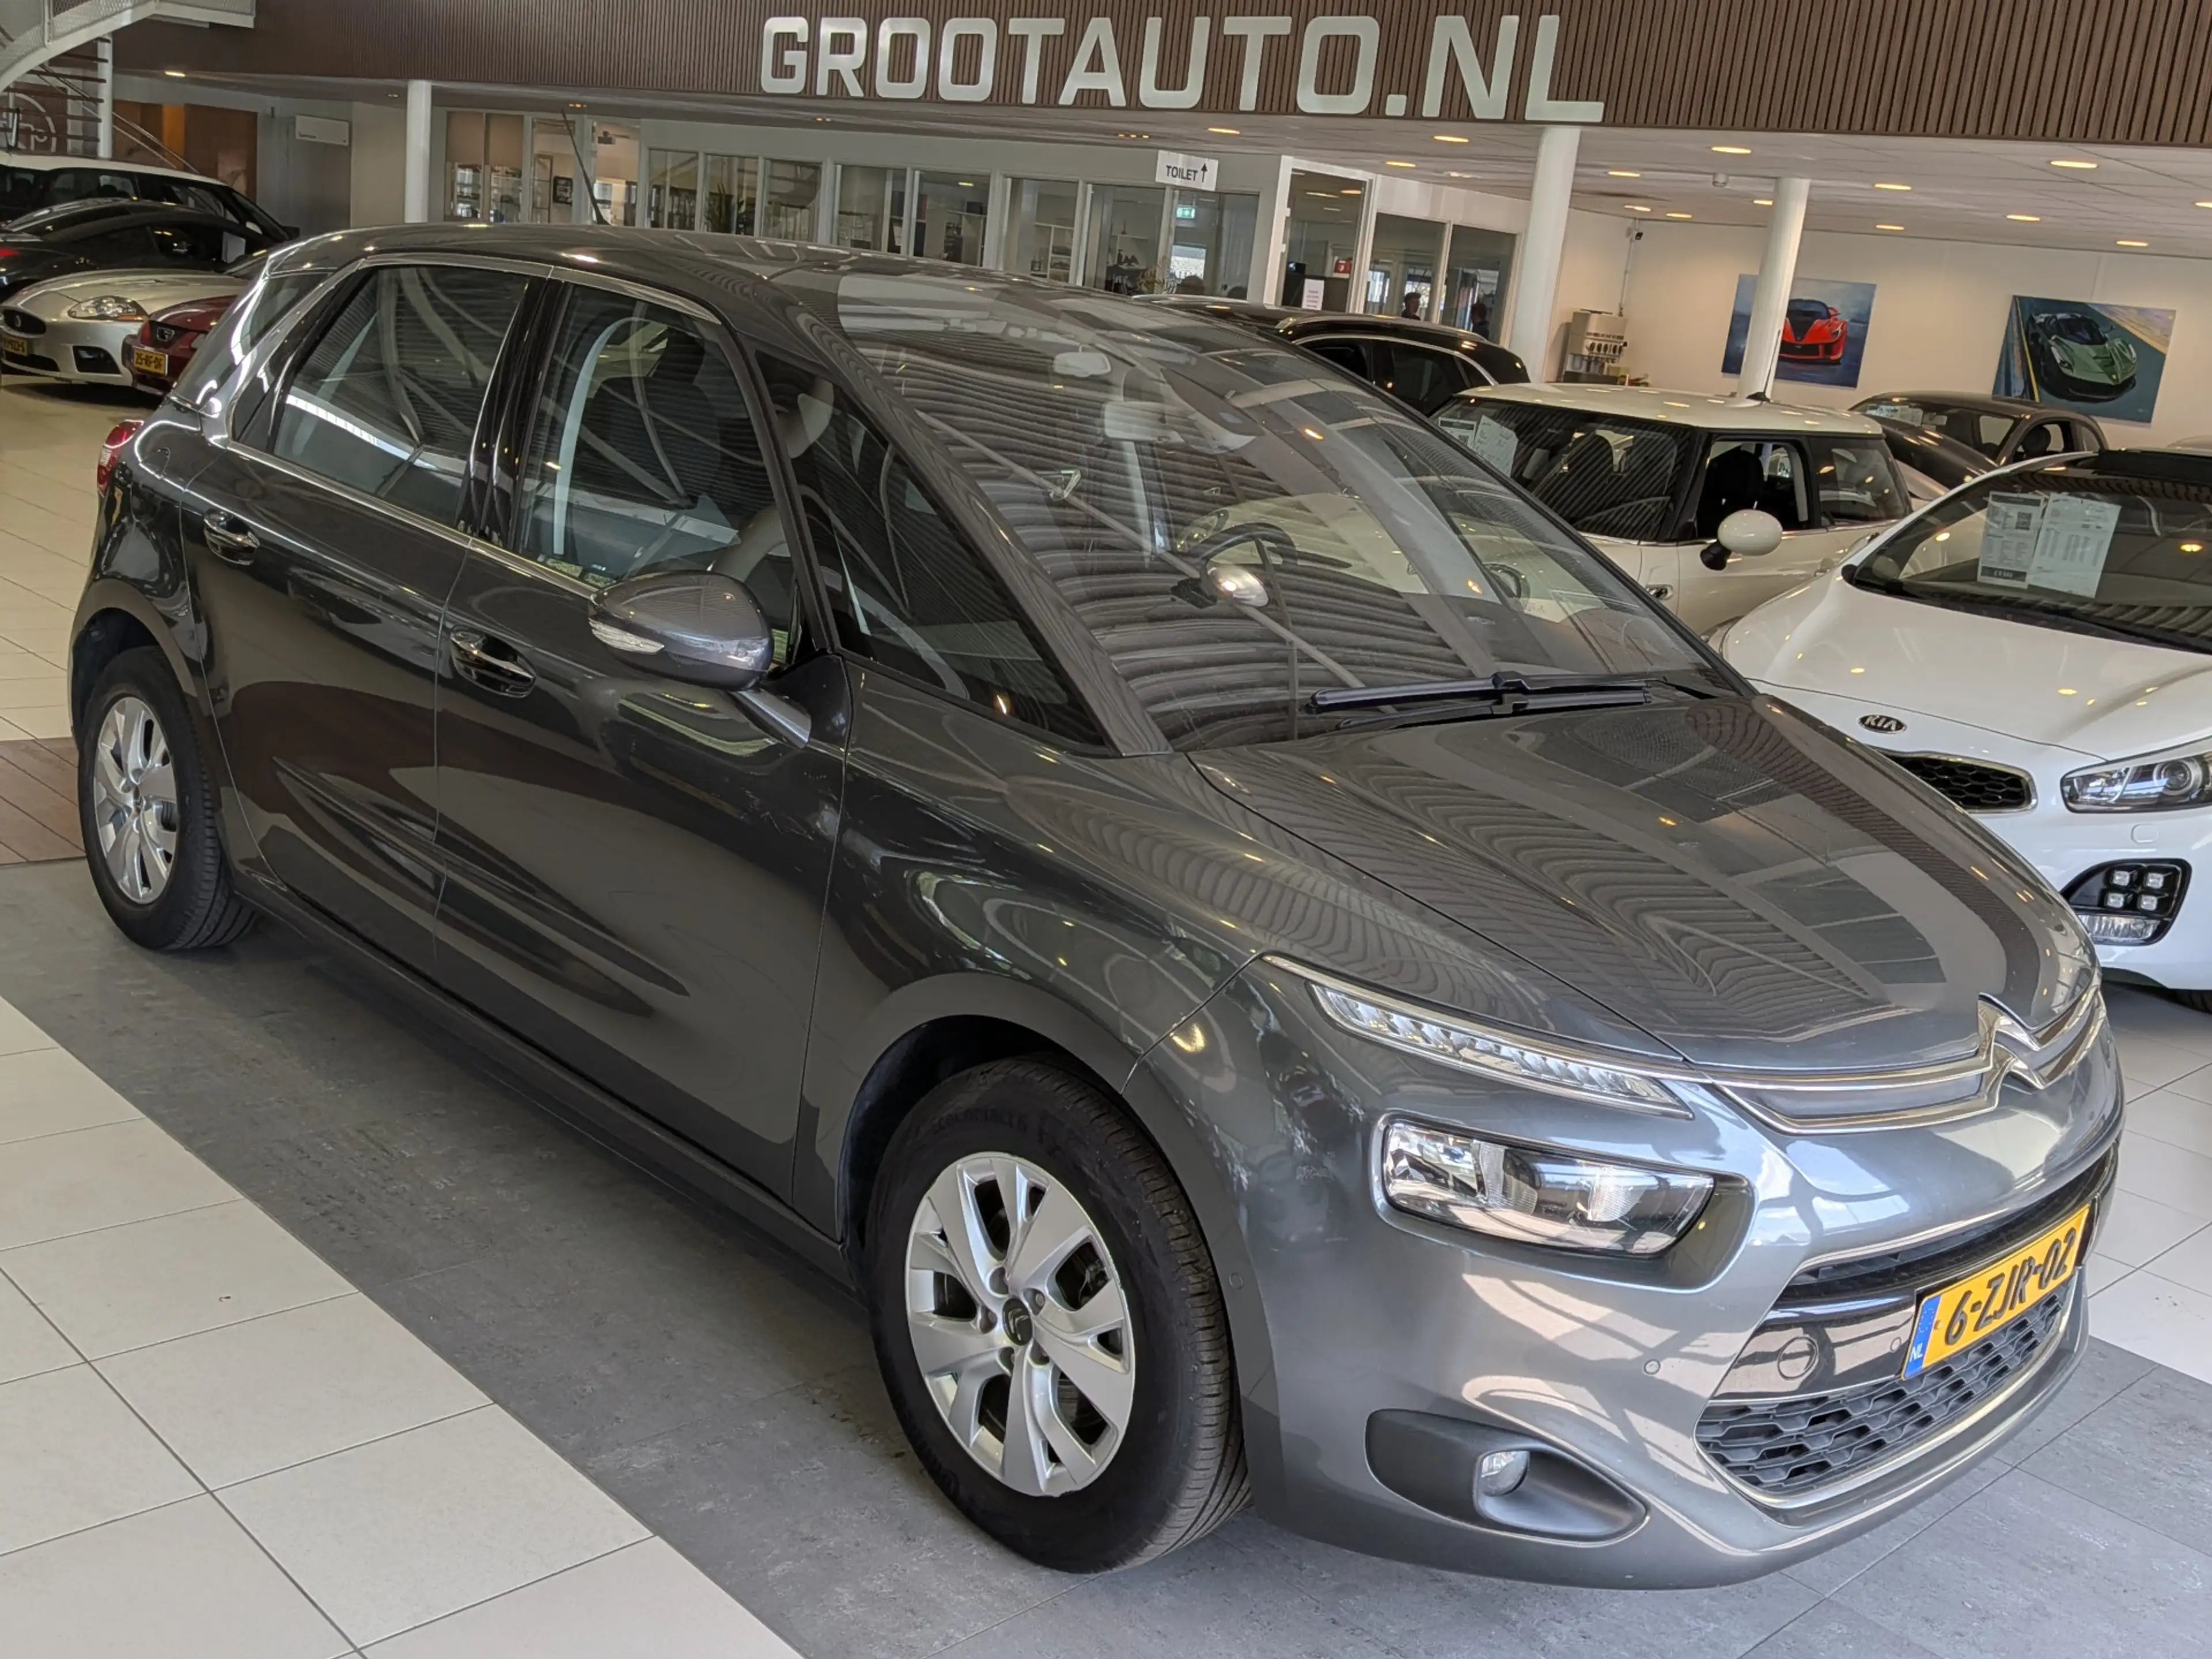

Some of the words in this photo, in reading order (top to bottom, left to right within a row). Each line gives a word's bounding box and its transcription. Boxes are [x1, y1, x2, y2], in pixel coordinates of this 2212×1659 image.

[760, 14, 1605, 123] GROOTAUTO.NL
[1165, 165, 1199, 182] TOILET
[1863, 715, 1897, 730] KIA
[1944, 1226, 2077, 1346] 6-ZJR-02
[1908, 1342, 1923, 1363] NL
